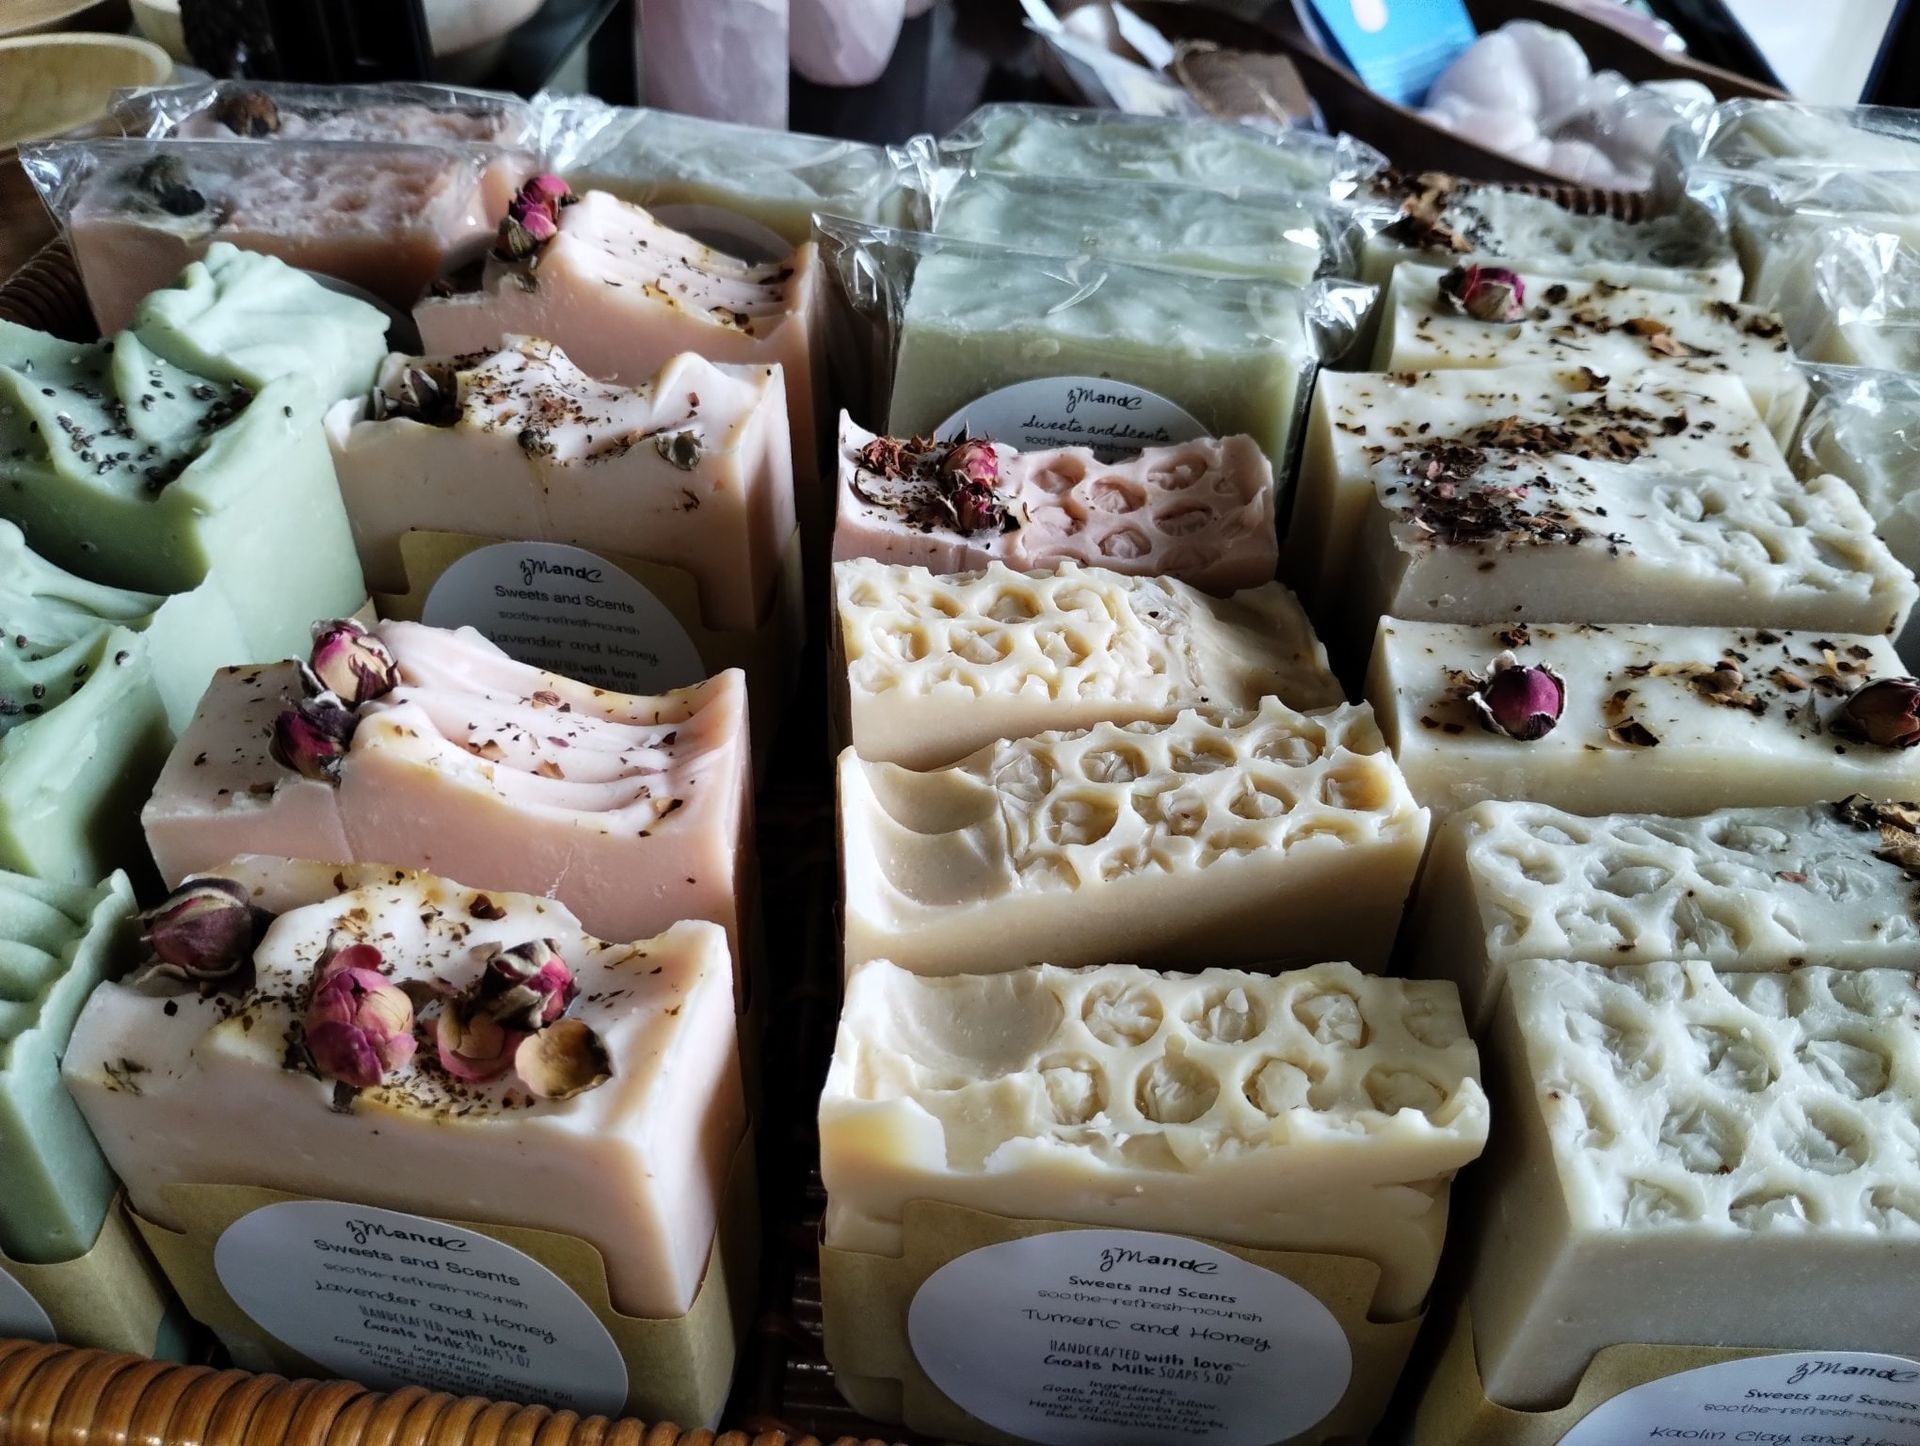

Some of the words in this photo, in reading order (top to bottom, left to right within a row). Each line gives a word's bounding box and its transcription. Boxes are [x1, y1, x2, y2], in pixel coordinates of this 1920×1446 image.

[1020, 414, 1085, 433] Sweets
[494, 584, 549, 602] Sweets
[553, 593, 582, 606] and
[584, 594, 636, 614] Scents
[569, 641, 602, 654] and
[313, 1239, 394, 1262] Sweets
[400, 1255, 440, 1271] and
[446, 1262, 521, 1287] Scents
[1099, 1247, 1219, 1275] zMandC
[314, 1280, 421, 1307] Lavender
[428, 1302, 476, 1321] and
[1067, 1274, 1133, 1292] Sweets
[1137, 1284, 1172, 1297] and
[1177, 1286, 1239, 1304] Scents
[1037, 1289, 1263, 1323] soothe-refresh-nourish
[363, 1319, 417, 1340] Goats
[424, 1333, 466, 1351] Milk
[1020, 1308, 1121, 1330] Tumeric
[1129, 1322, 1180, 1337] and
[446, 1327, 484, 1343] with
[489, 1334, 528, 1354] love
[1049, 1338, 1140, 1361] HANDCRAFTED
[1143, 1352, 1184, 1367] with
[1043, 1353, 1102, 1371] Goats
[1111, 1361, 1156, 1376] Milk
[1160, 1365, 1199, 1382] SOAPS
[1743, 1388, 1812, 1402] Sweets
[1815, 1393, 1854, 1403] and
[1648, 1426, 1727, 1441] Kaolin
